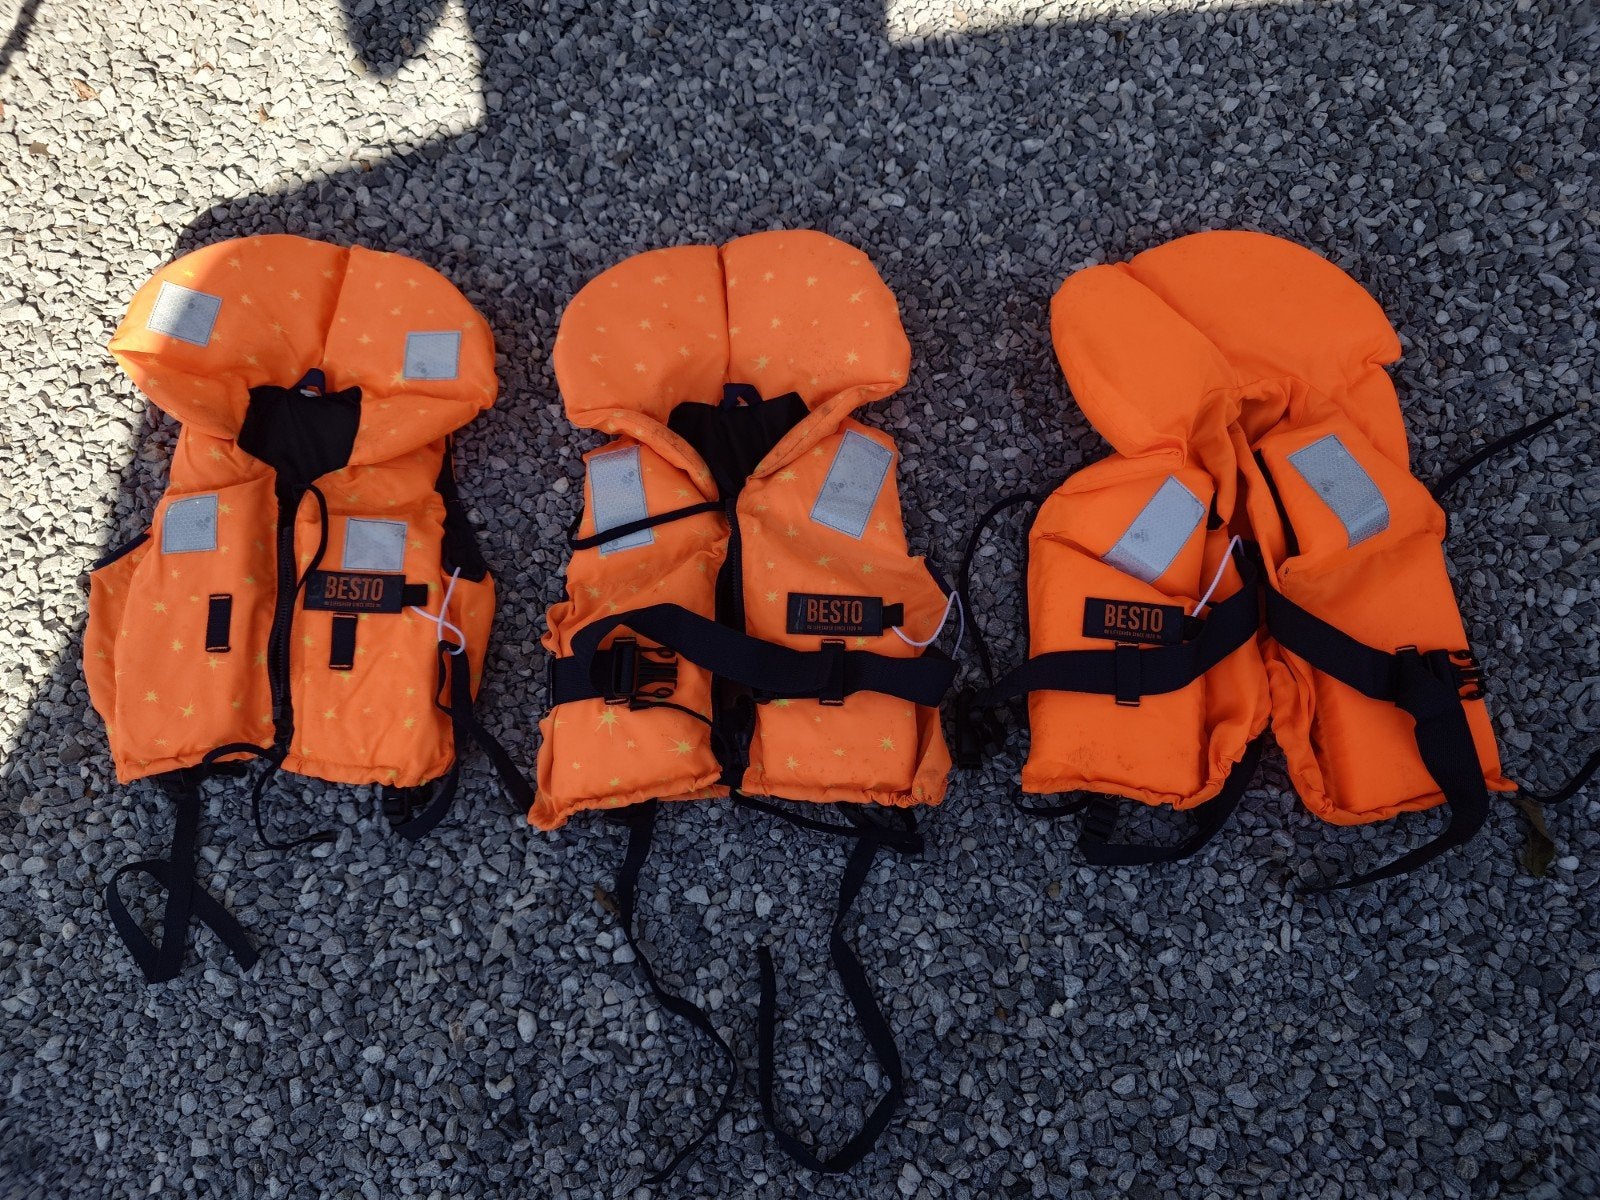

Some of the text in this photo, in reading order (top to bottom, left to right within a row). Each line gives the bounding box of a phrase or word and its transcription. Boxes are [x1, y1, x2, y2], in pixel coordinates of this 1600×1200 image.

[324, 575, 384, 601] BESTO
[807, 598, 863, 624] BESTO
[1104, 603, 1163, 632] BESTO
